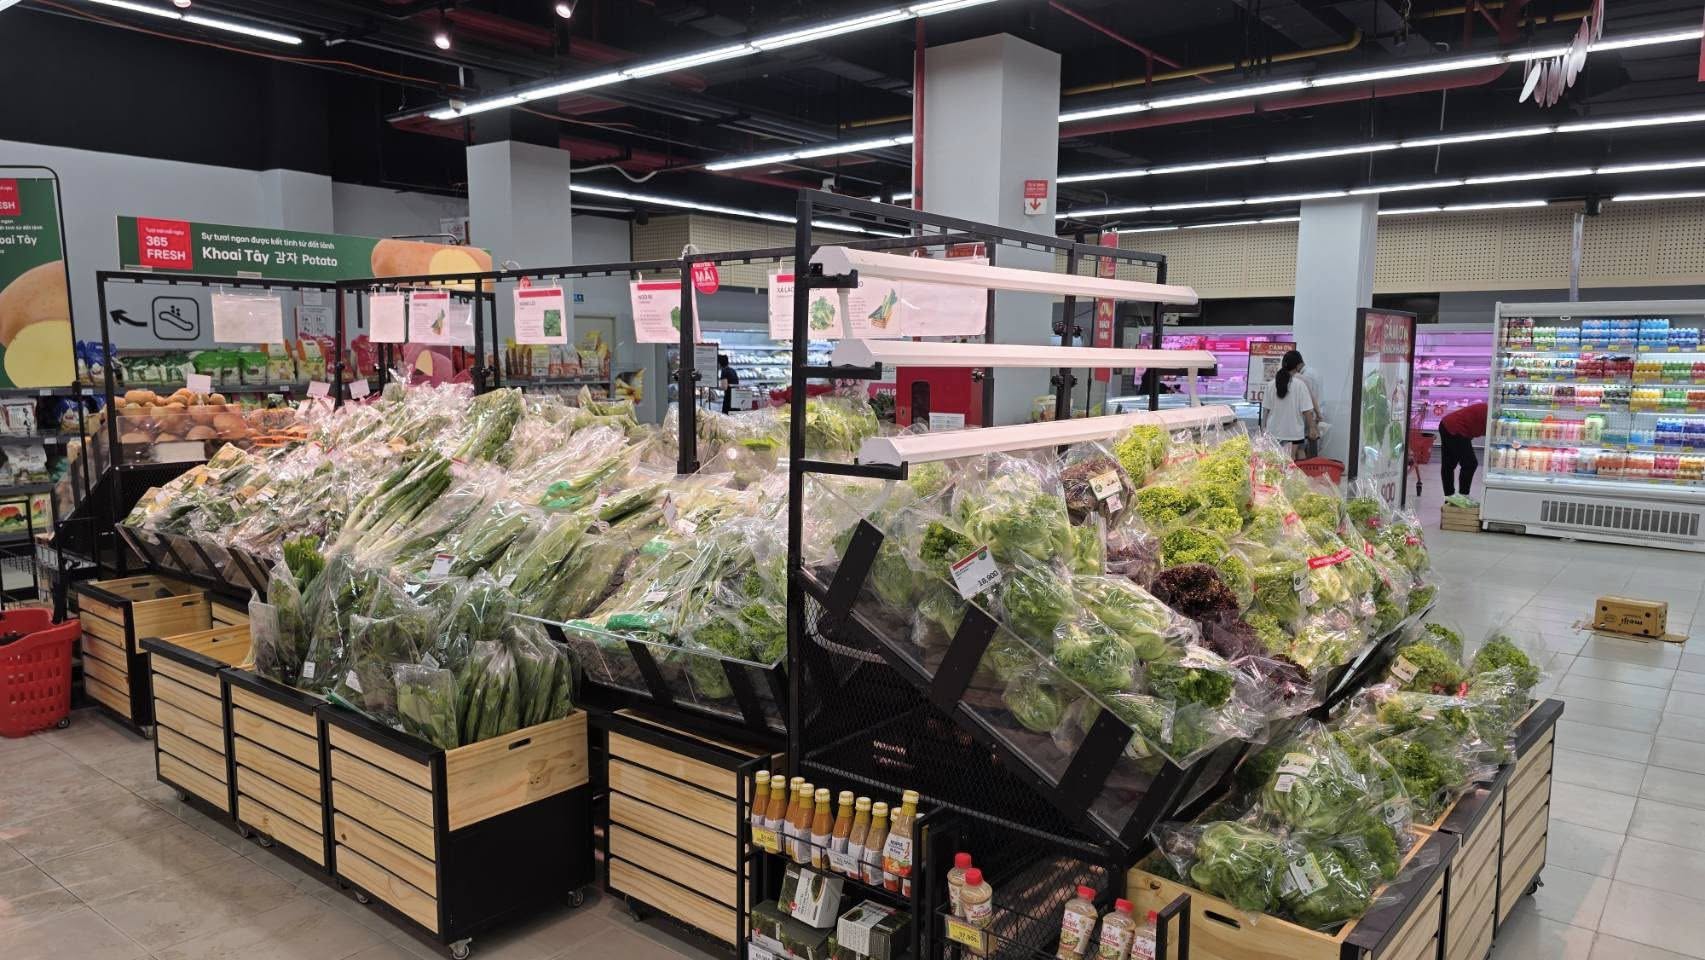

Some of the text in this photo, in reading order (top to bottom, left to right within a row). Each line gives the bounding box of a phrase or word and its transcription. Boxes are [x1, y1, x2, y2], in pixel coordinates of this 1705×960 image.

[17, 234, 37, 246] Tây
[146, 235, 168, 247] 365
[201, 232, 212, 241] Sự
[146, 248, 186, 261] FRESH
[202, 246, 338, 267] Khoai Tây 감자 Potato
